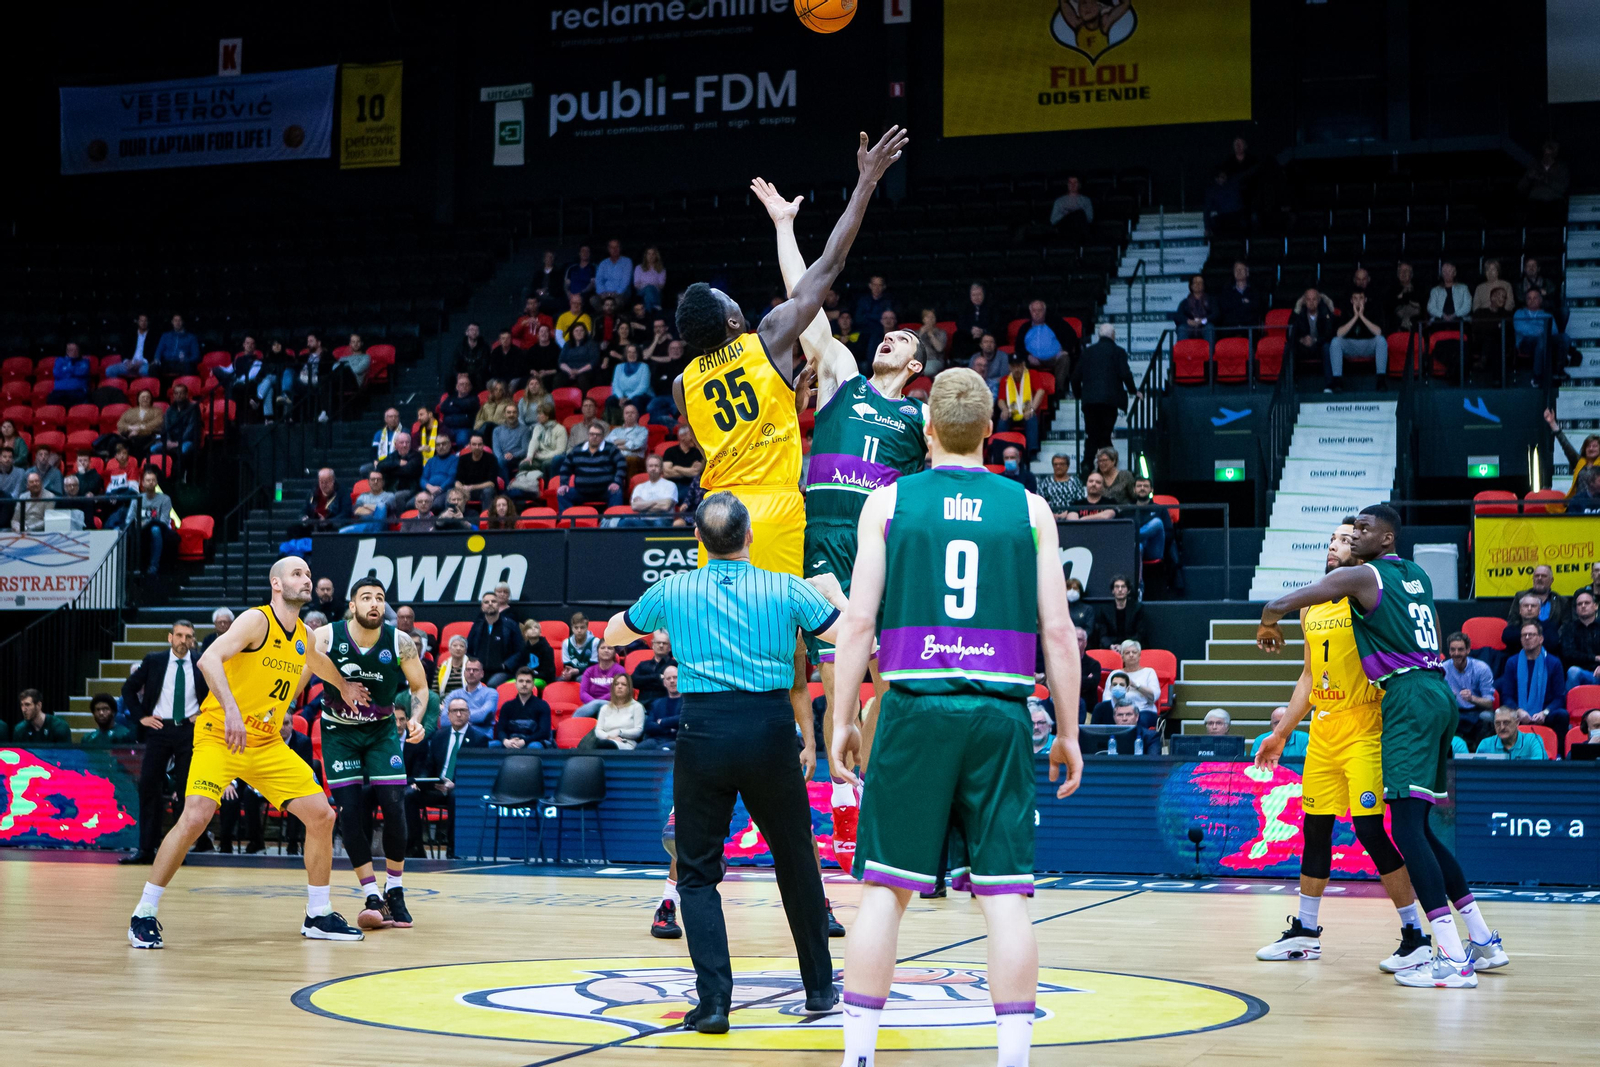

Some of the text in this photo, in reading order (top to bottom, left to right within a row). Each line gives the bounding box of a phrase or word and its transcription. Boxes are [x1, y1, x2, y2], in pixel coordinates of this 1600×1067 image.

[223, 45, 237, 70] K
[1050, 64, 1139, 90] FILOU
[121, 89, 236, 110] VESELIN
[487, 85, 533, 100] UITGANG
[549, 68, 798, 138] publi-FDM
[1038, 86, 1151, 105] OOSTENDE
[357, 94, 385, 122] 10
[575, 126, 604, 137] visual
[606, 121, 685, 136] communication
[694, 120, 719, 132] print
[758, 114, 798, 127] display
[120, 136, 147, 158] OUR
[149, 133, 205, 155] CAPTAIN
[207, 131, 235, 152] FOR
[699, 346, 745, 374] BRIMAH
[703, 366, 760, 433] 35
[1326, 403, 1380, 414] Ostend-Bruges
[874, 414, 907, 432] Unicaja
[862, 434, 880, 464] 11
[1318, 435, 1374, 446] Ostend-Bruges
[1309, 469, 1367, 480] Ostend-Bruges
[943, 493, 983, 522] DÍAZ
[1301, 503, 1360, 515] Ostend-Bruges
[643, 547, 698, 567] CAS
[1291, 542, 1329, 553] Ostend-B
[1488, 541, 1594, 565] TIME OUT!
[345, 534, 529, 602] bwin
[944, 539, 979, 620] 9
[1486, 567, 1513, 578] TIJD
[1517, 566, 1534, 577] VO
[1555, 563, 1580, 574] EEN
[1407, 602, 1439, 651] 33
[1322, 639, 1330, 663] 1
[359, 670, 384, 682] Unicaja
[268, 678, 291, 702] 20
[1312, 688, 1346, 701] FILOU
